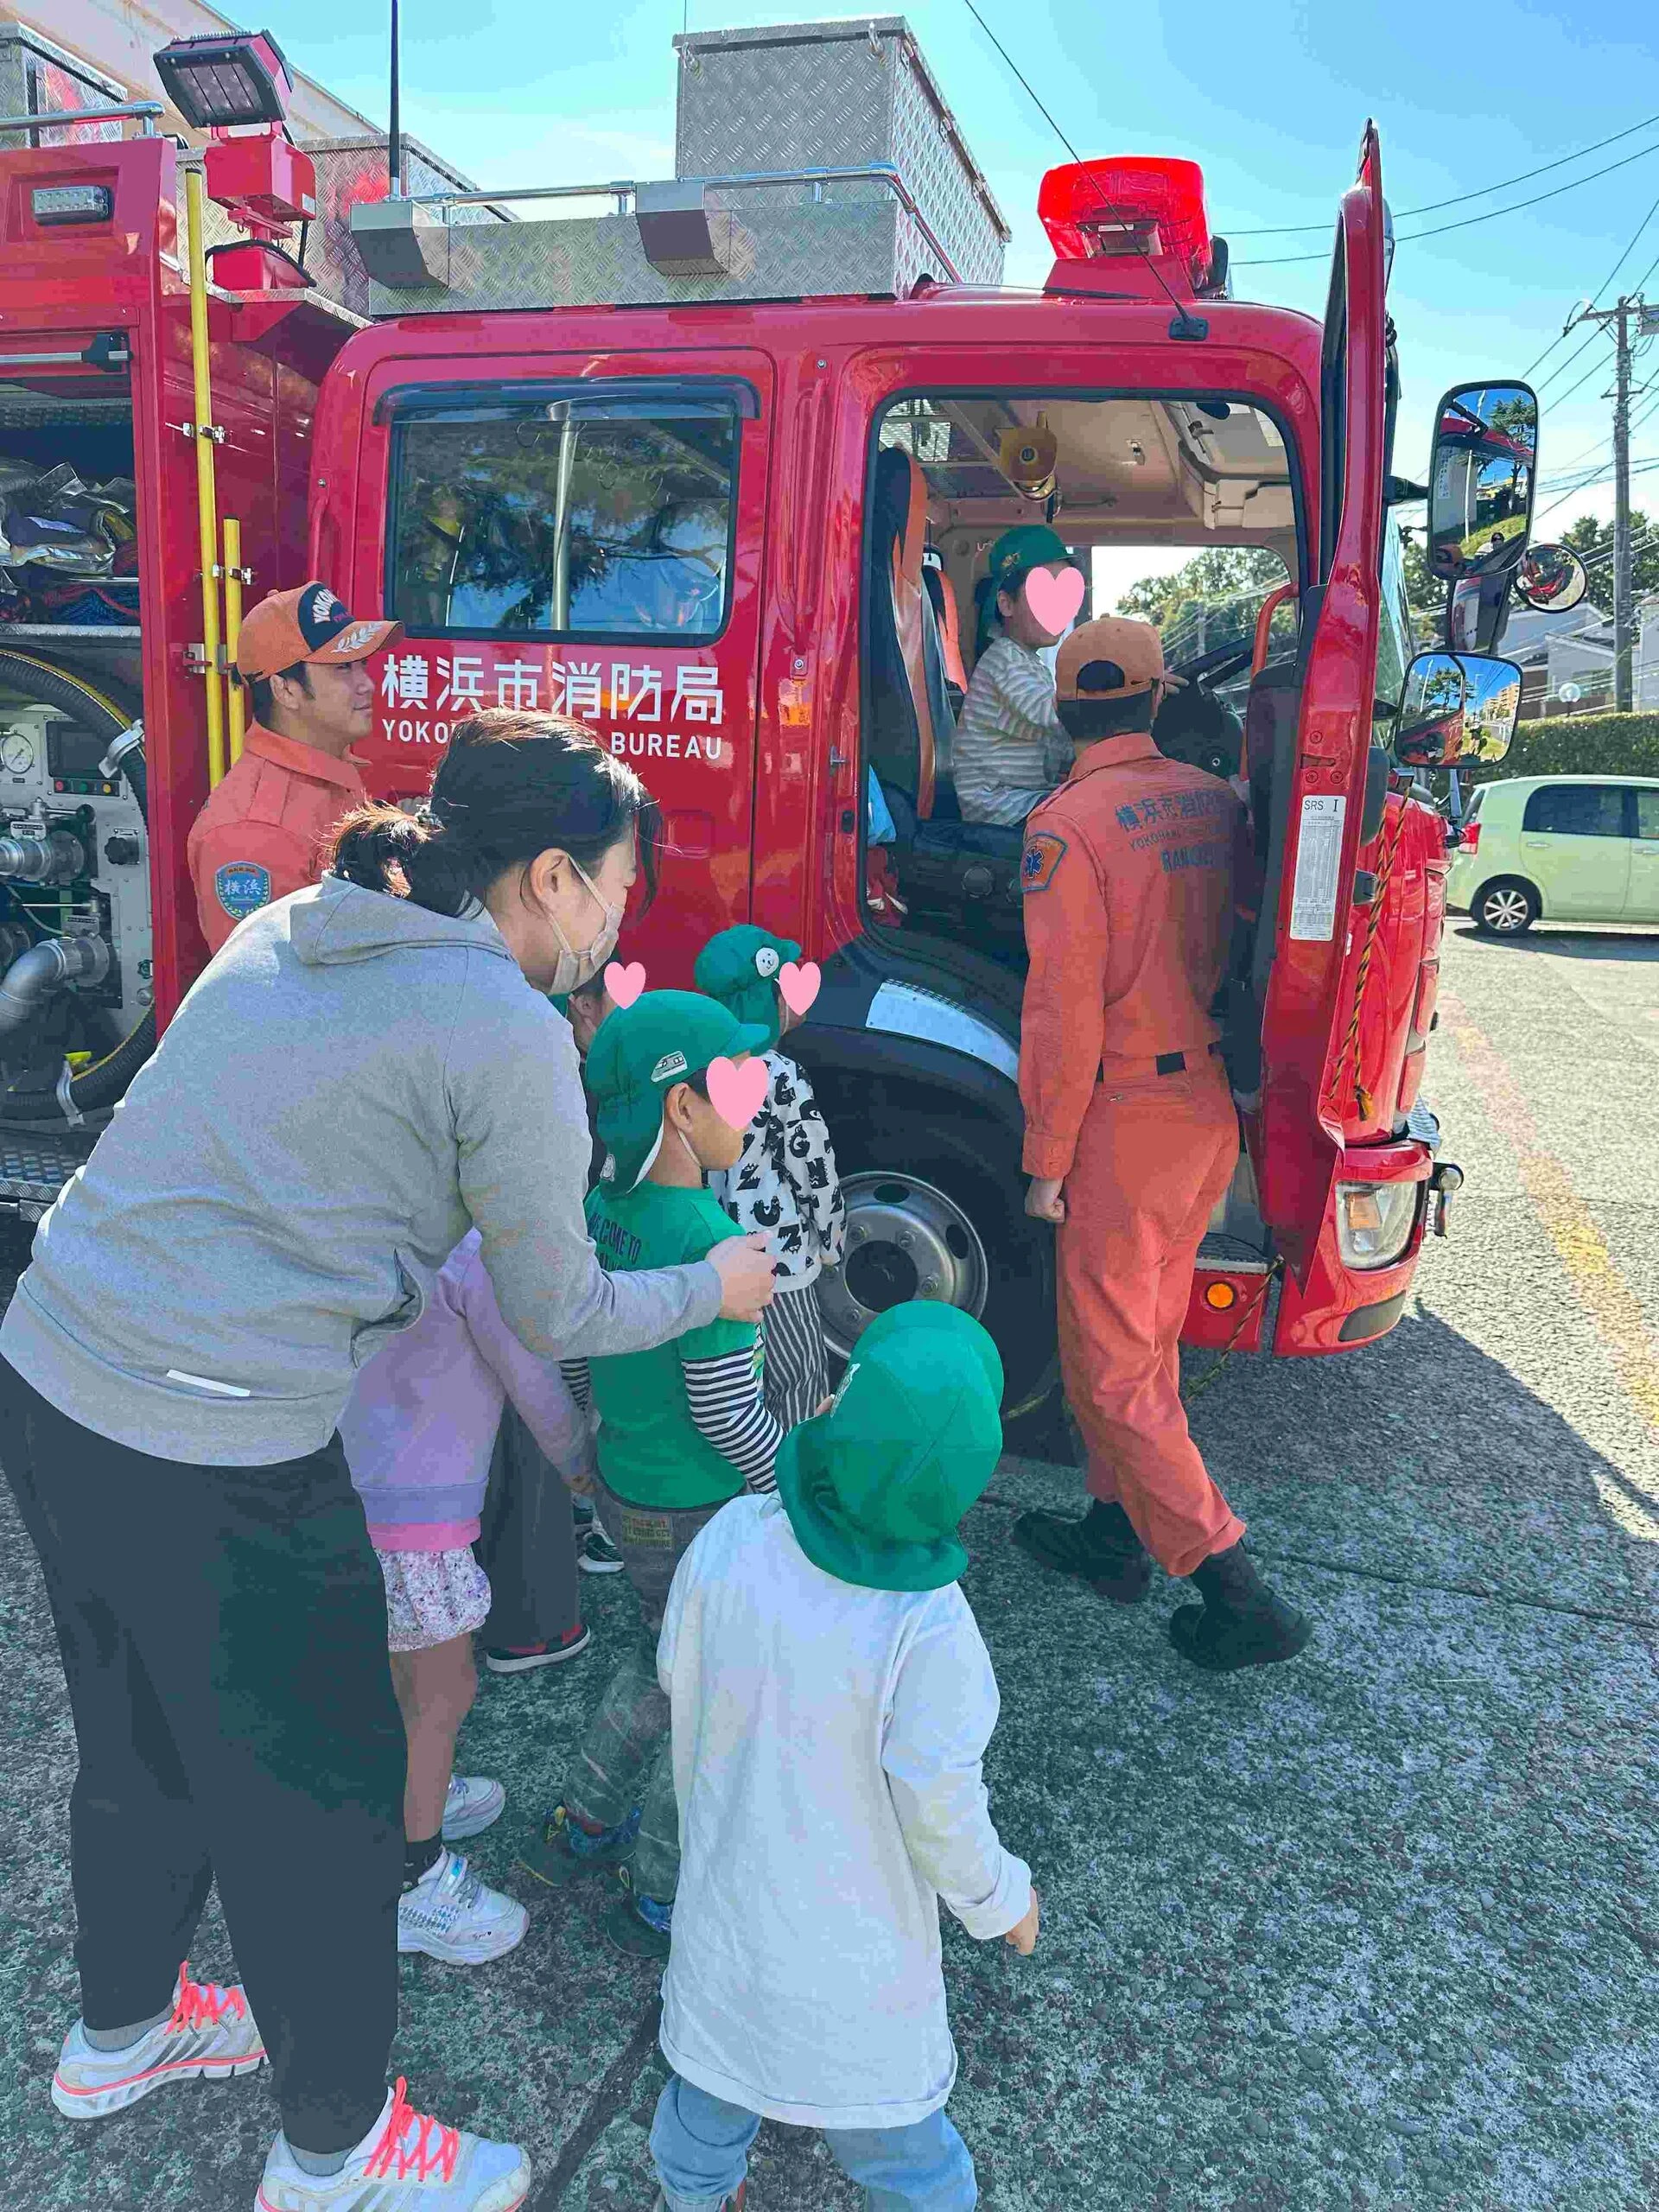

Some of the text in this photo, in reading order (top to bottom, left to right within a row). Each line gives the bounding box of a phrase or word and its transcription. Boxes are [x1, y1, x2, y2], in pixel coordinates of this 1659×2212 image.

[312, 588, 341, 624] YOKO
[381, 653, 723, 725] 横浜市消防局
[381, 718, 721, 760] YOKO BUREAU
[1114, 790, 1227, 832] 横浜市消防
[1304, 799, 1324, 810] SRS
[224, 878, 263, 896] 横浜
